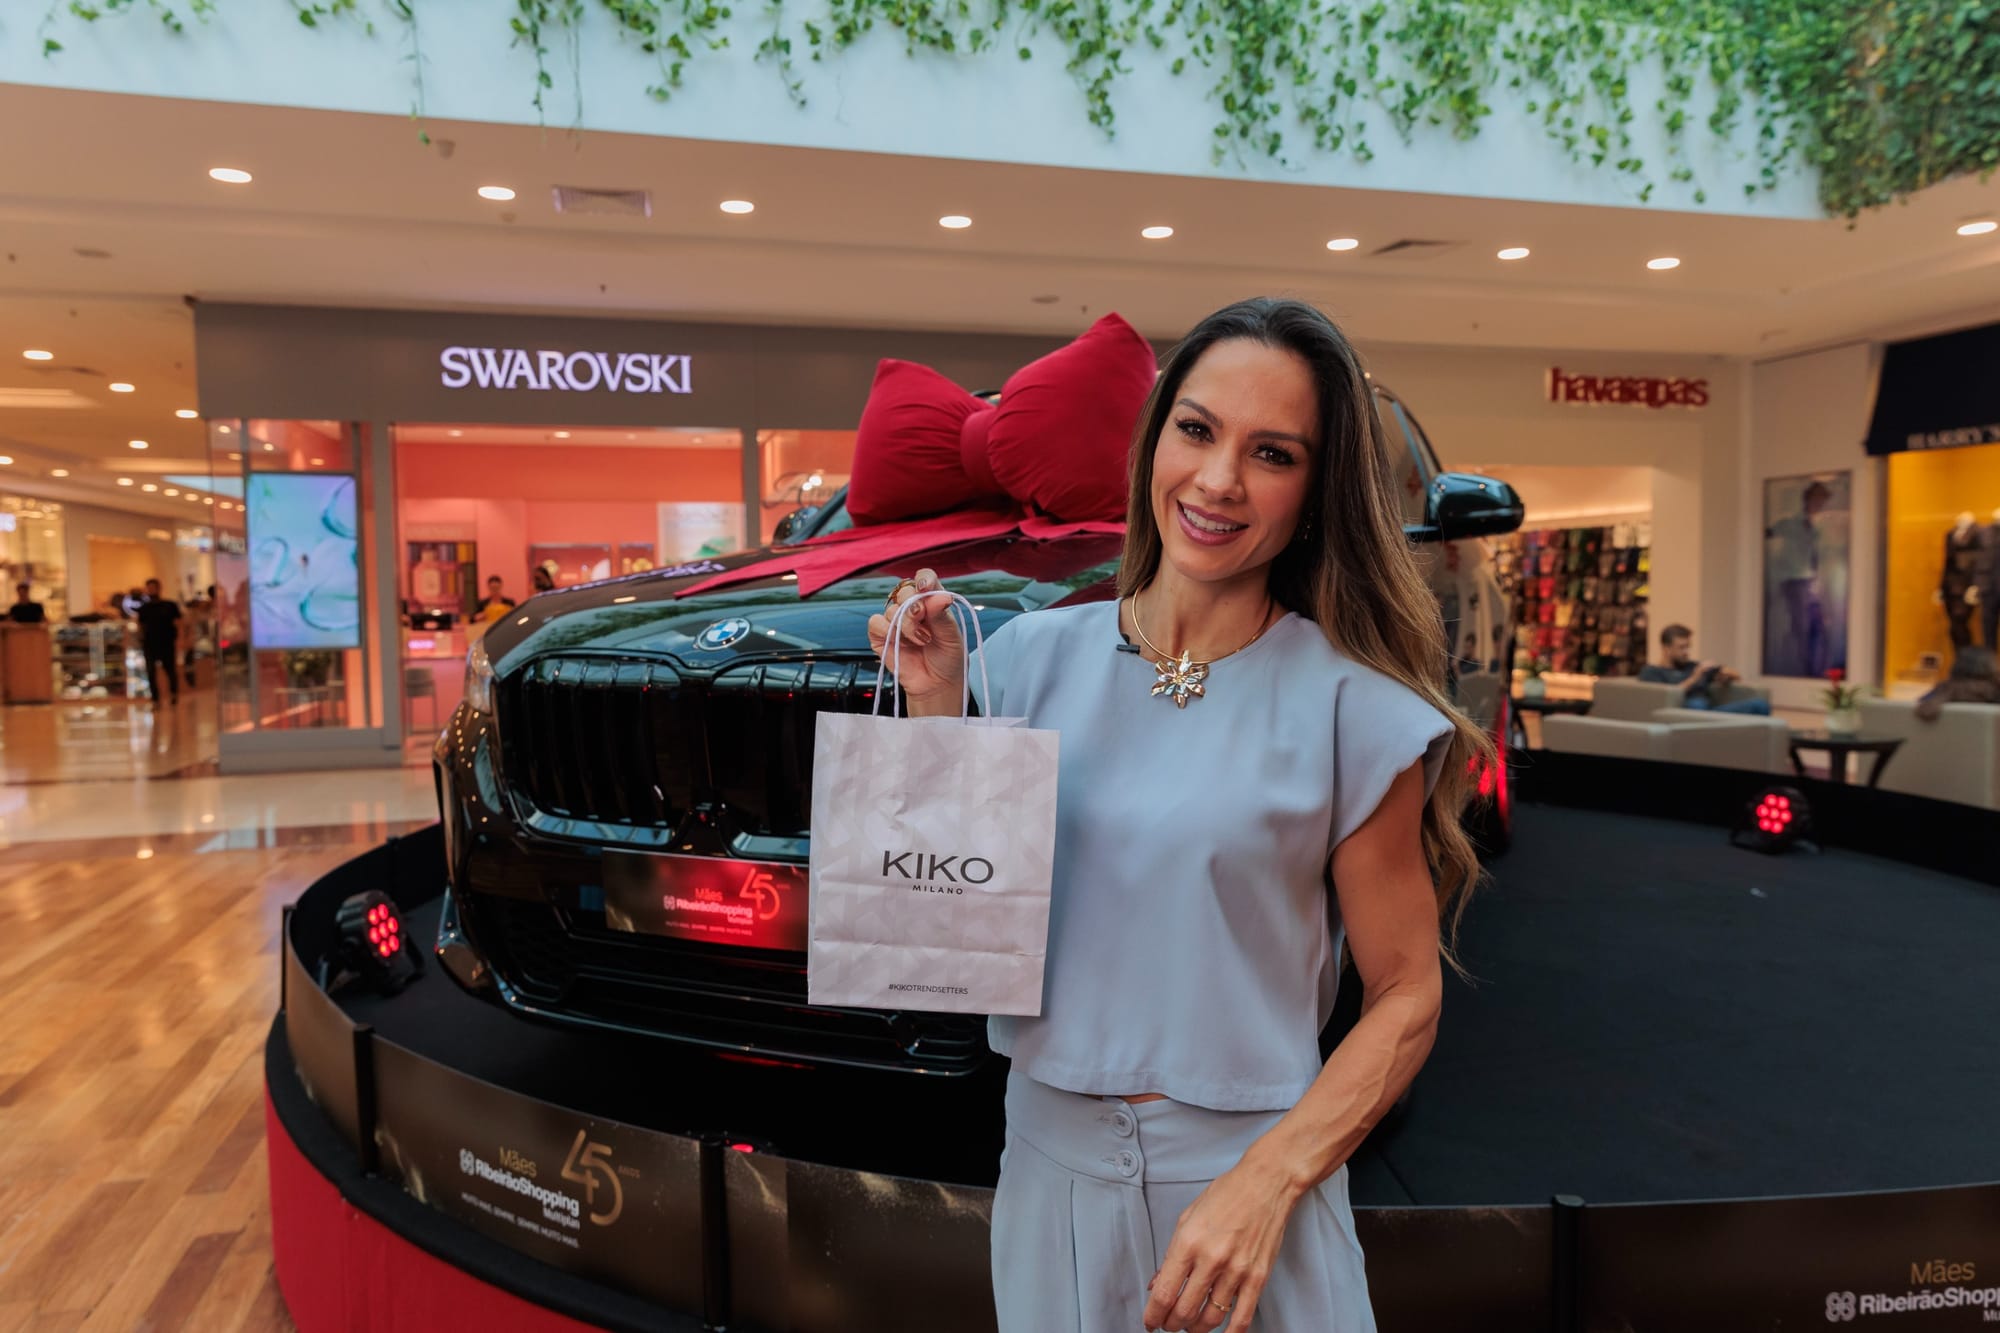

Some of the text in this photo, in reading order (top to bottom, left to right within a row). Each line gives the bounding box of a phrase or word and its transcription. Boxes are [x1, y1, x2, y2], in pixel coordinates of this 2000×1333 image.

[440, 346, 693, 394] SWAROVSKI
[882, 850, 994, 884] KIKO
[912, 884, 964, 895] MILANO
[888, 983, 969, 995] #KIKOTRENDSETTERS
[499, 1146, 537, 1178] Mães
[560, 1129, 623, 1227] 45
[475, 1158, 580, 1217] RibeirãoShopping
[1910, 1259, 1976, 1286] Mães
